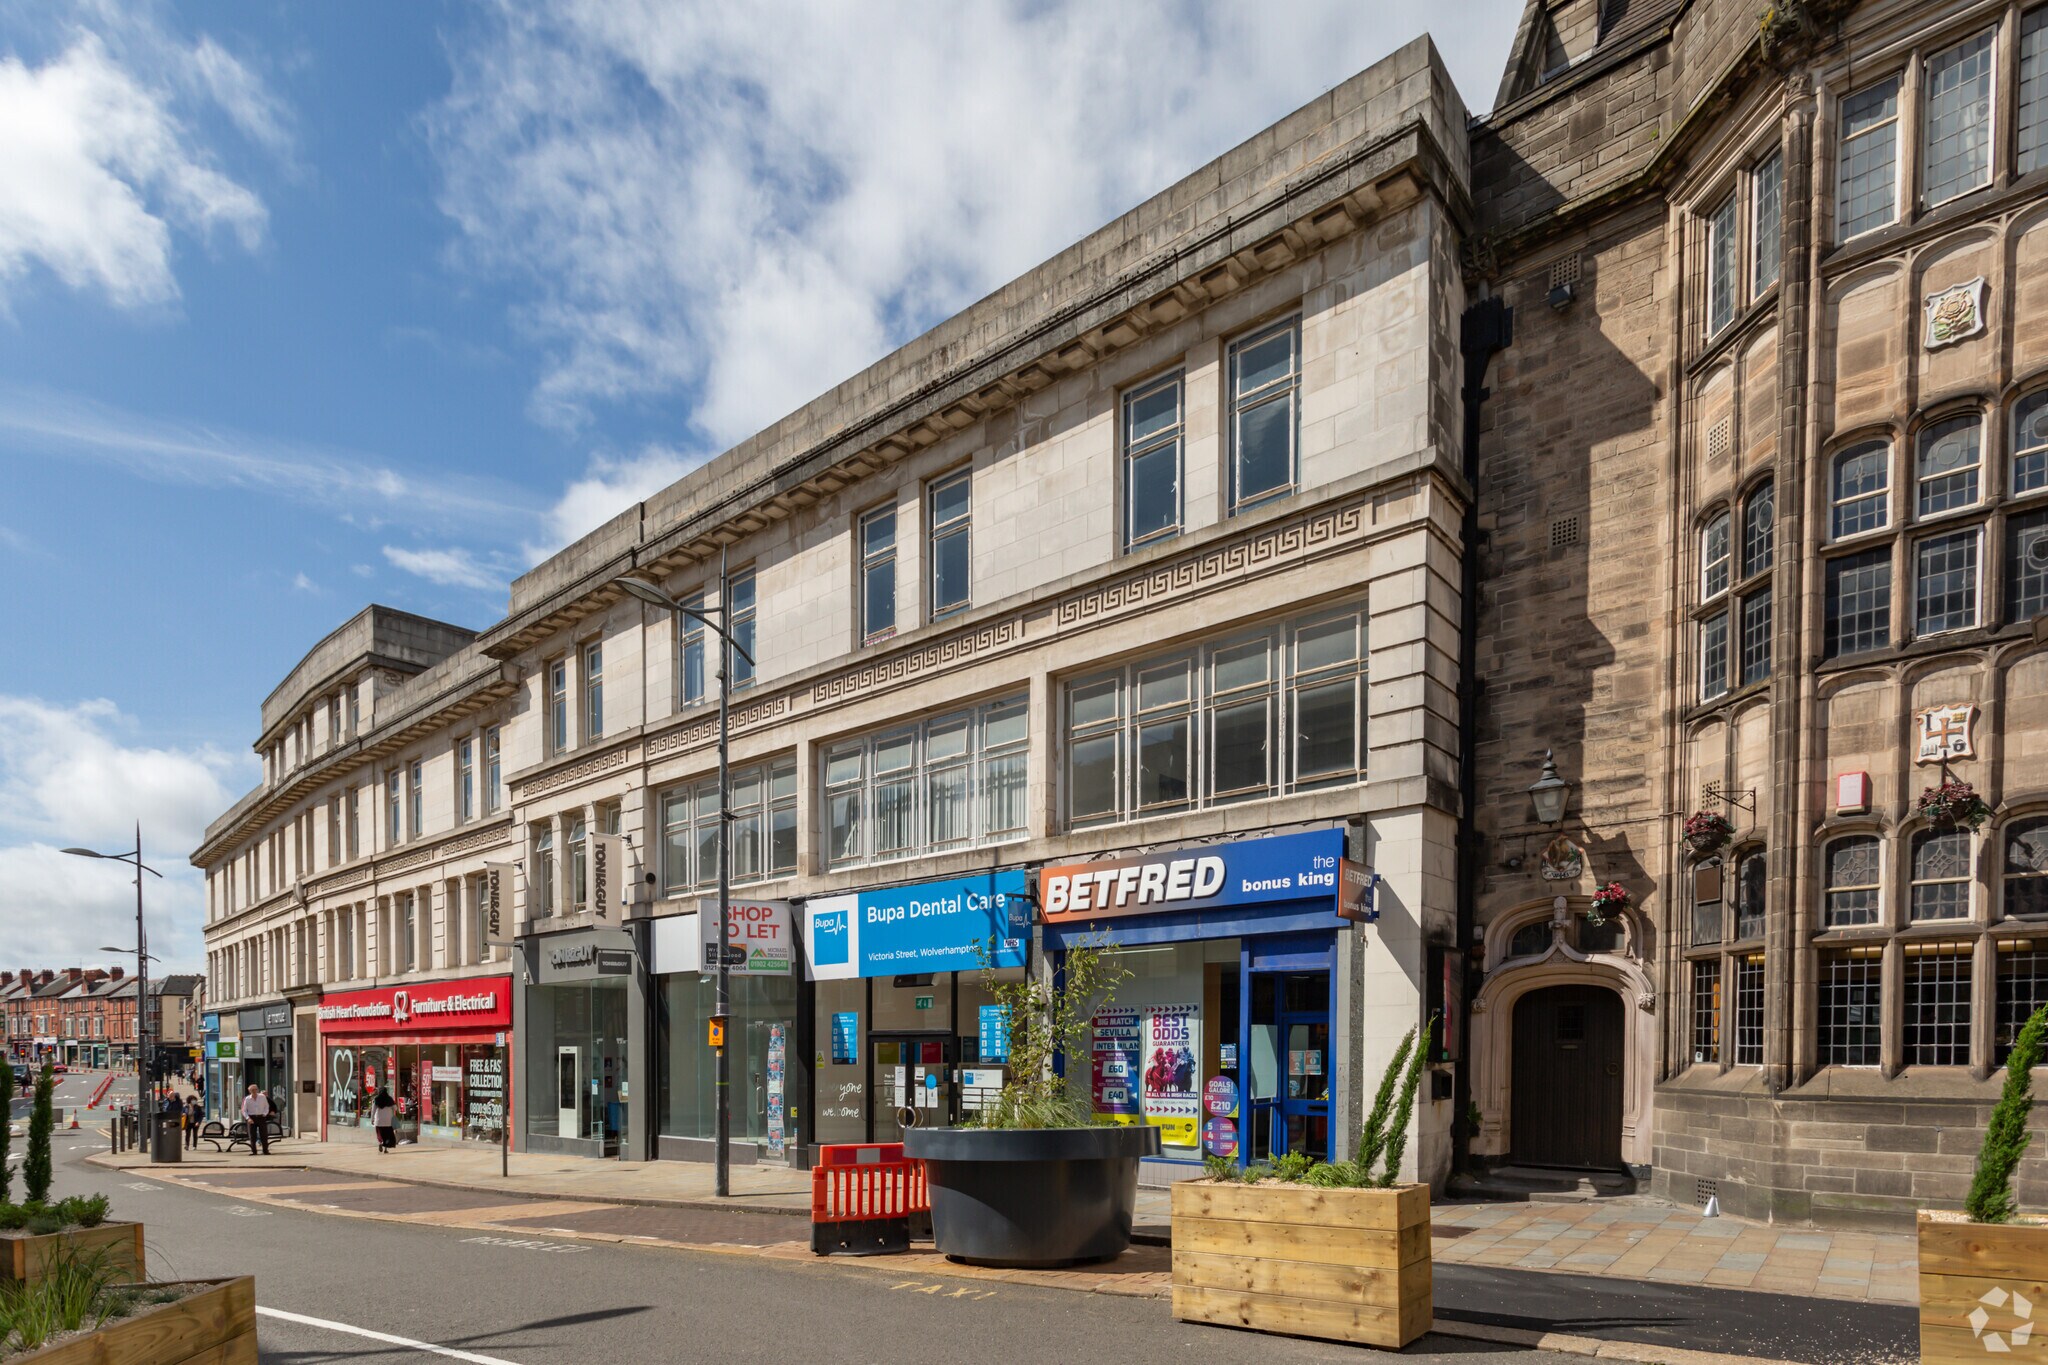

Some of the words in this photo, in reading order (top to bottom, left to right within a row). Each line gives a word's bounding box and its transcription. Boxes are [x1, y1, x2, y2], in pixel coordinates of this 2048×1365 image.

[1313, 855, 1335, 869] the
[595, 842, 607, 920] TONI&GUY
[1046, 855, 1226, 914] BETFRED
[1242, 876, 1291, 893] bonus
[1298, 872, 1335, 890] king
[1344, 868, 1373, 888] BETFRED
[489, 869, 500, 937] TONI&GUY
[867, 905, 905, 924] Bupa
[909, 894, 961, 918] Dental
[966, 892, 1006, 911] Care
[1343, 898, 1360, 911] bonus
[1360, 902, 1372, 916] king
[815, 918, 834, 929] Bupa
[1008, 913, 1023, 922] Bupa
[747, 924, 780, 939] LET
[1004, 939, 1018, 947] NHS
[868, 951, 894, 962] Victoria
[895, 949, 918, 960] Street,
[318, 1005, 336, 1020] British
[336, 1004, 353, 1018] Heart
[353, 1001, 392, 1018] Foundation
[411, 997, 446, 1014] Furniture
[447, 997, 455, 1011] &
[454, 992, 496, 1011] Electrical
[1097, 1018, 1108, 1026] BIG
[1110, 1017, 1134, 1025] MATCH
[1152, 1013, 1190, 1027] BEST
[1100, 1029, 1132, 1037] SEVILLA
[1152, 1027, 1190, 1041] ODDS
[1096, 1042, 1115, 1050] INTER
[1116, 1042, 1139, 1050] MILAN
[470, 1059, 484, 1072] FREE
[484, 1059, 490, 1072] &
[1108, 1065, 1124, 1073] £60
[421, 1086, 431, 1096] OFF
[1108, 1091, 1124, 1099] £40
[1210, 1101, 1231, 1111] £210
[1207, 1122, 1213, 1131] 5
[1207, 1132, 1214, 1140] 4
[1207, 1141, 1214, 1149] 3
[890, 1280, 998, 1301] TAXI
